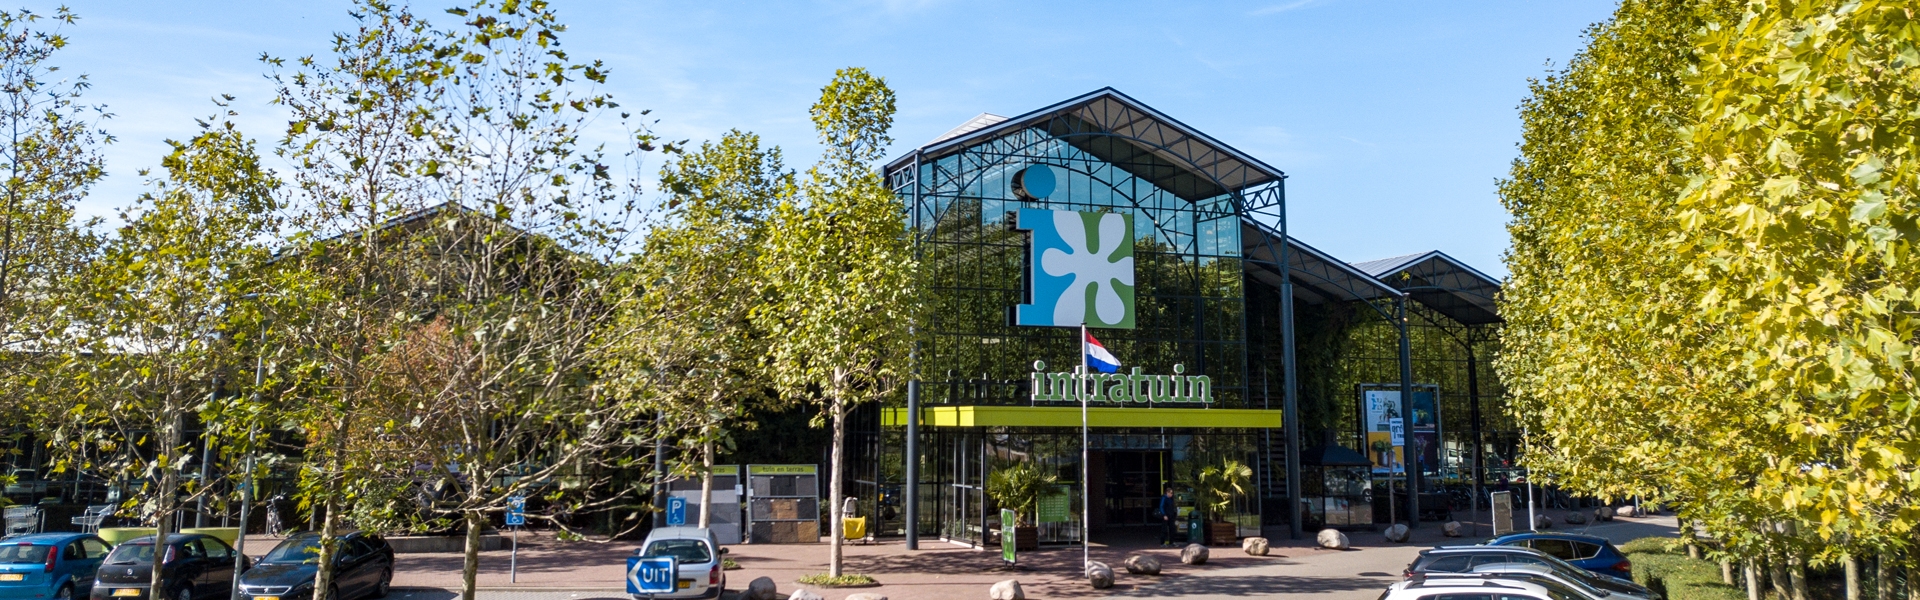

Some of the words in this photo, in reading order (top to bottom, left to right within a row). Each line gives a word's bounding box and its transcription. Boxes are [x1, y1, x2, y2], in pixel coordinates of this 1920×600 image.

[1031, 360, 1215, 404] intratuin
[672, 500, 682, 513] P
[642, 568, 668, 583] UIT
